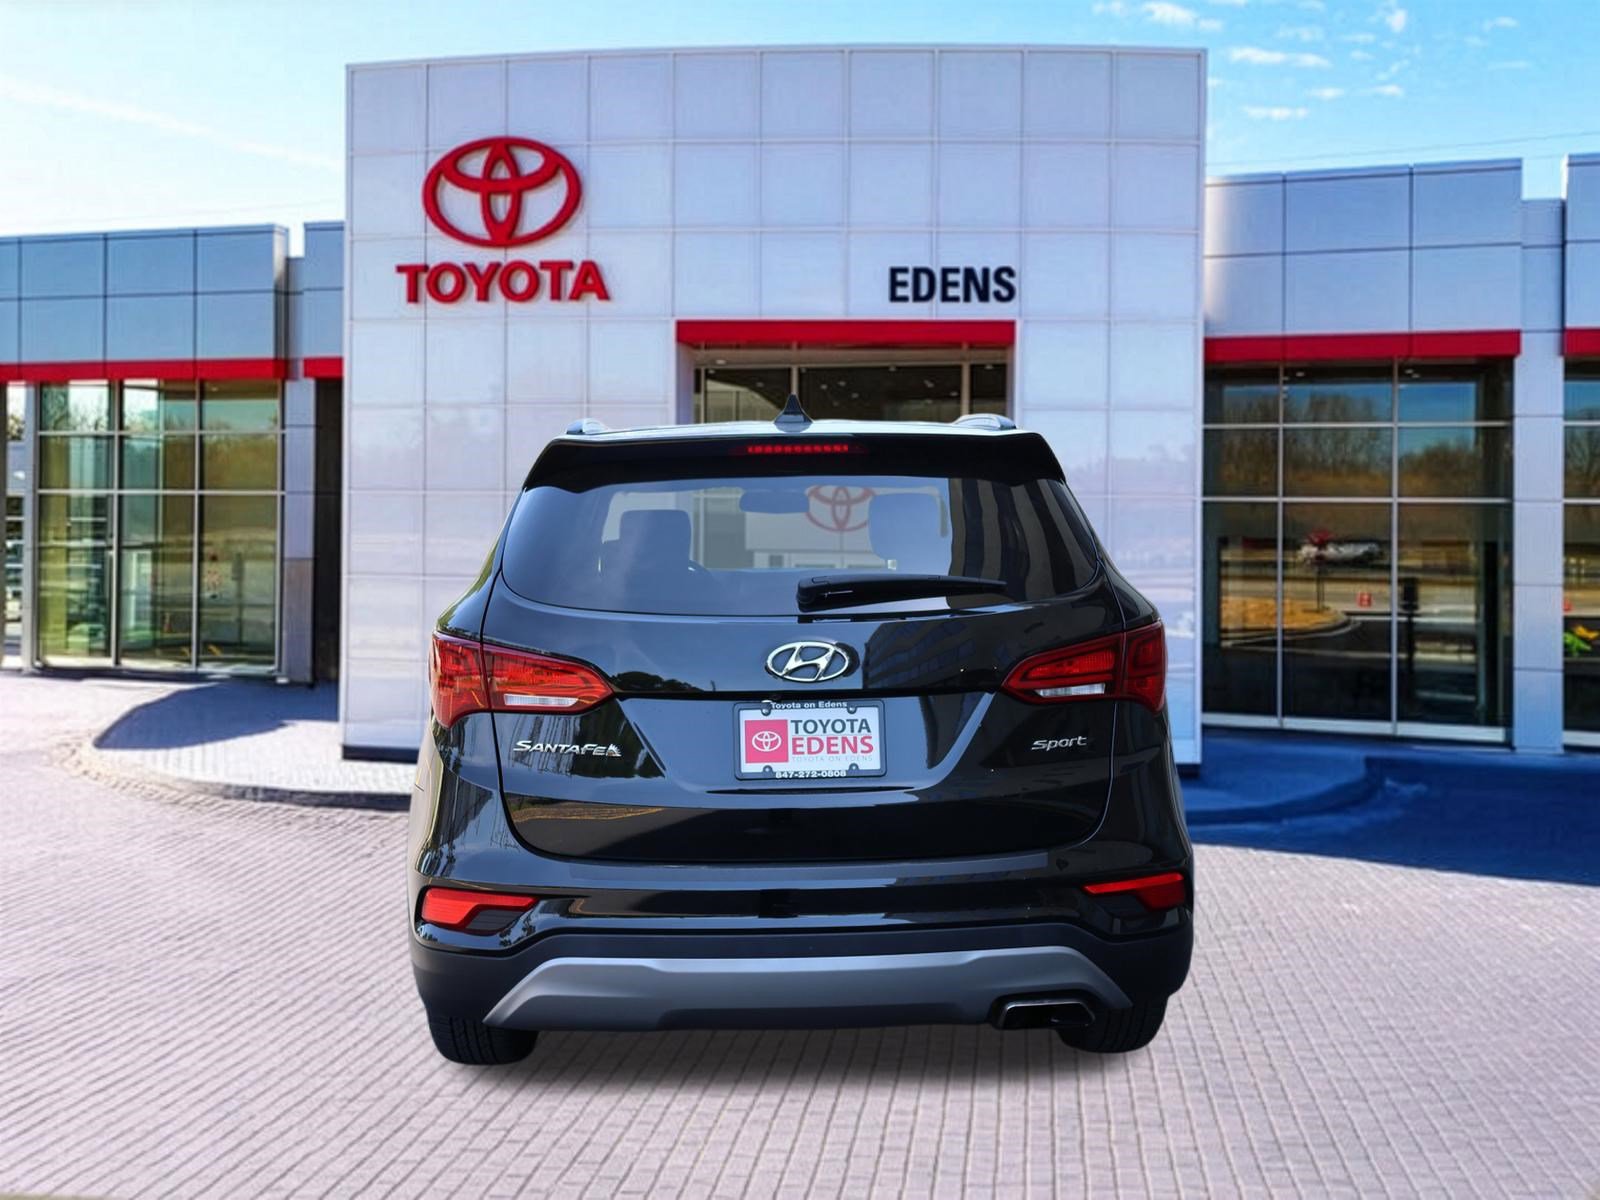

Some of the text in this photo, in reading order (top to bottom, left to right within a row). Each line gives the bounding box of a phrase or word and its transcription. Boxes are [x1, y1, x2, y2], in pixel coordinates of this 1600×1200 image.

[395, 259, 610, 304] TOYOTA
[889, 266, 1016, 303] EDENS
[770, 702, 801, 710] Toyota
[791, 718, 871, 734] TOYOTA
[792, 735, 874, 755] EDENS
[1031, 736, 1087, 751] Sport
